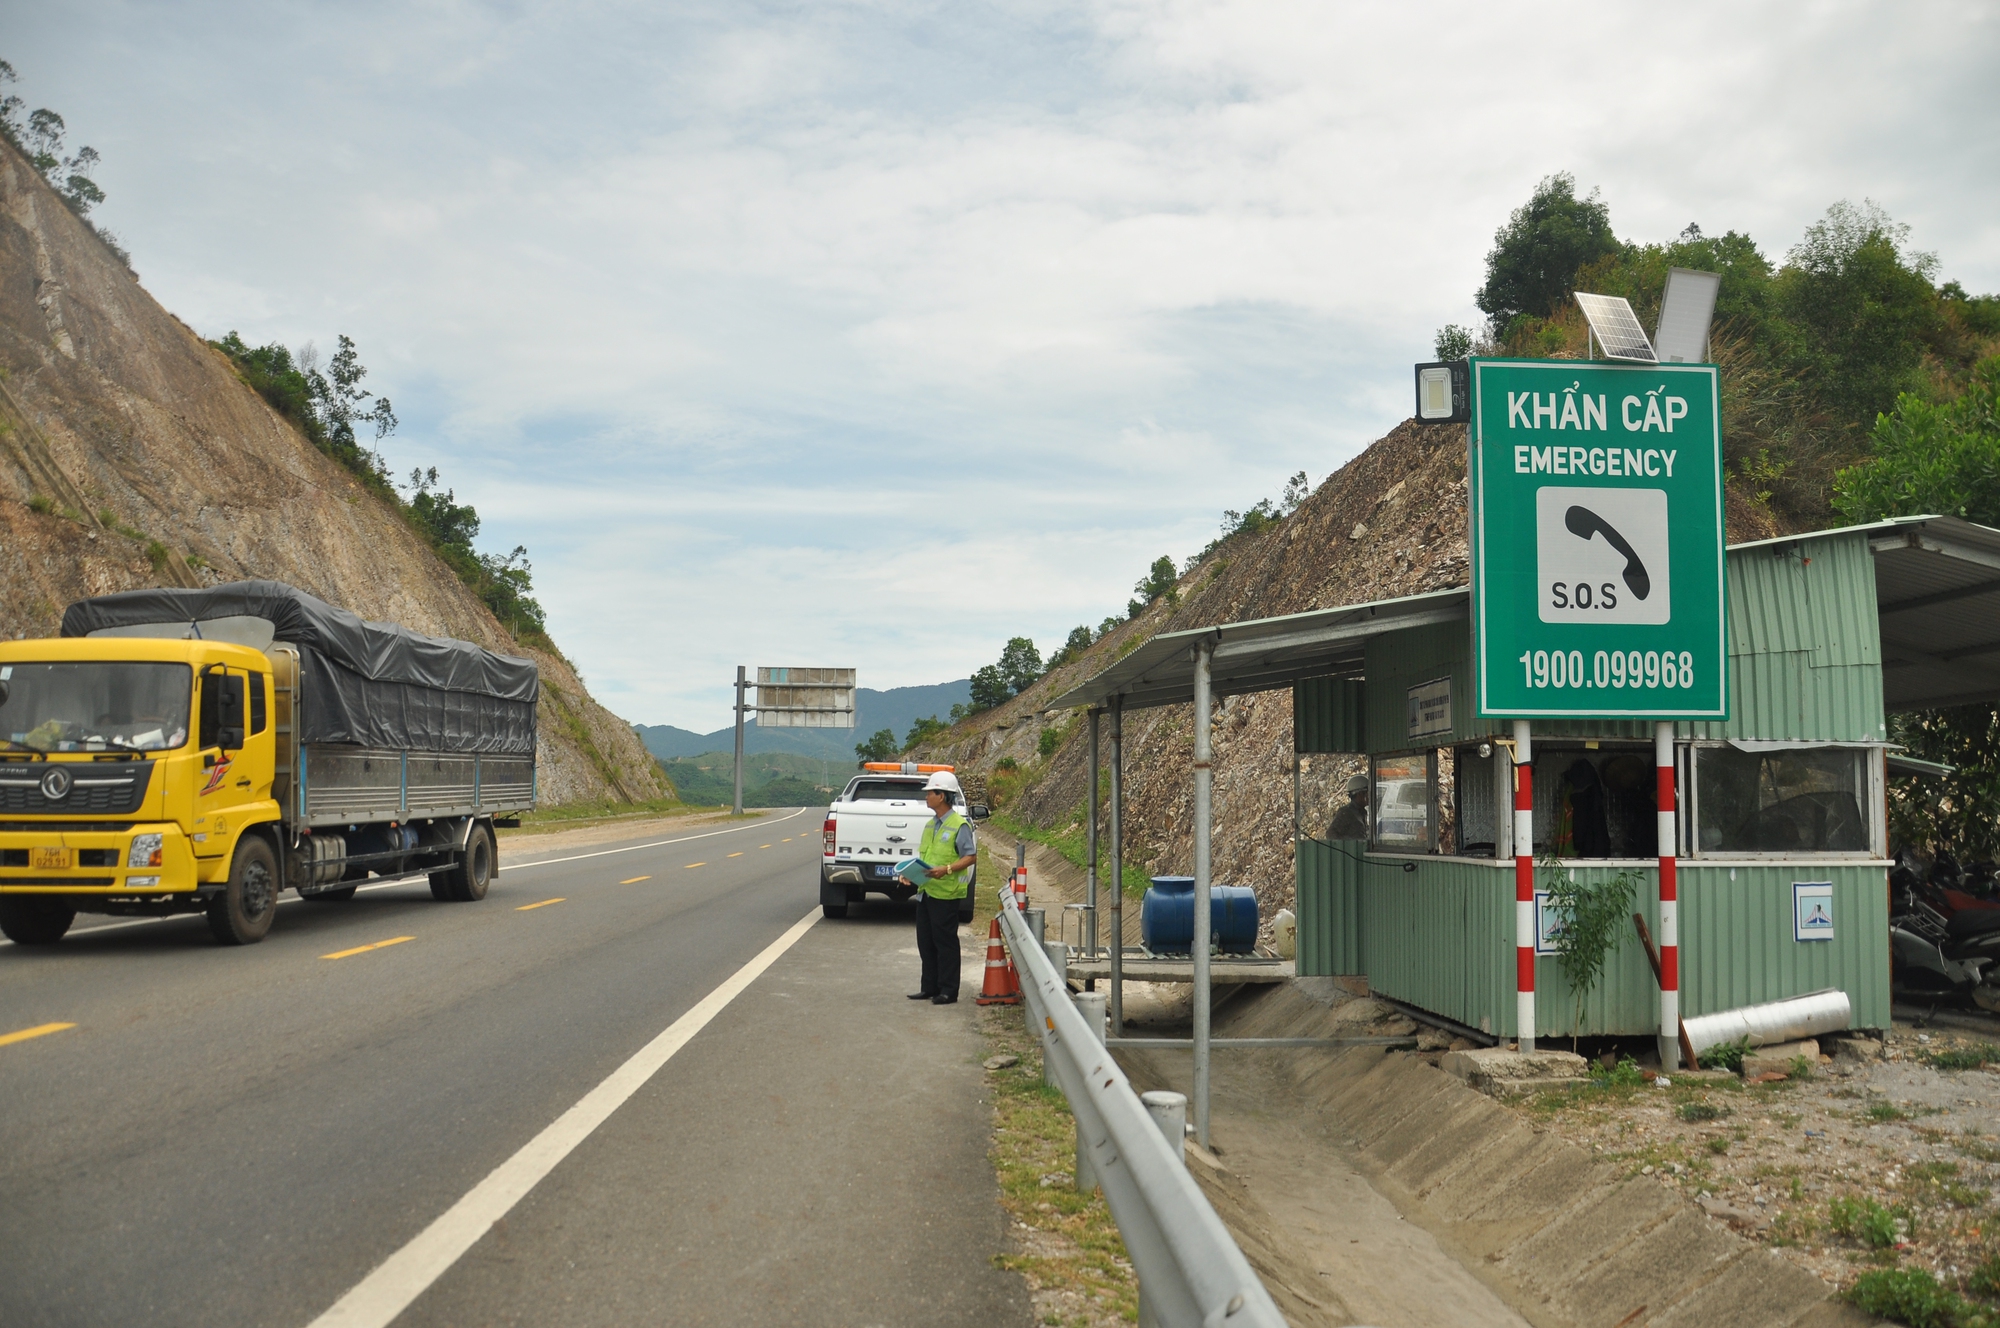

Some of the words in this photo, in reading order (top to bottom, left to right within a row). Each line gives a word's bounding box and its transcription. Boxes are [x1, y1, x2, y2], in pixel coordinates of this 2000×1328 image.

[1508, 381, 1607, 431] KHẨN
[1622, 385, 1689, 433] CẤP
[1515, 446, 1677, 478] EMERGENCY
[1552, 581, 1617, 610] S.O.S
[1519, 650, 1694, 689] 1900.099968
